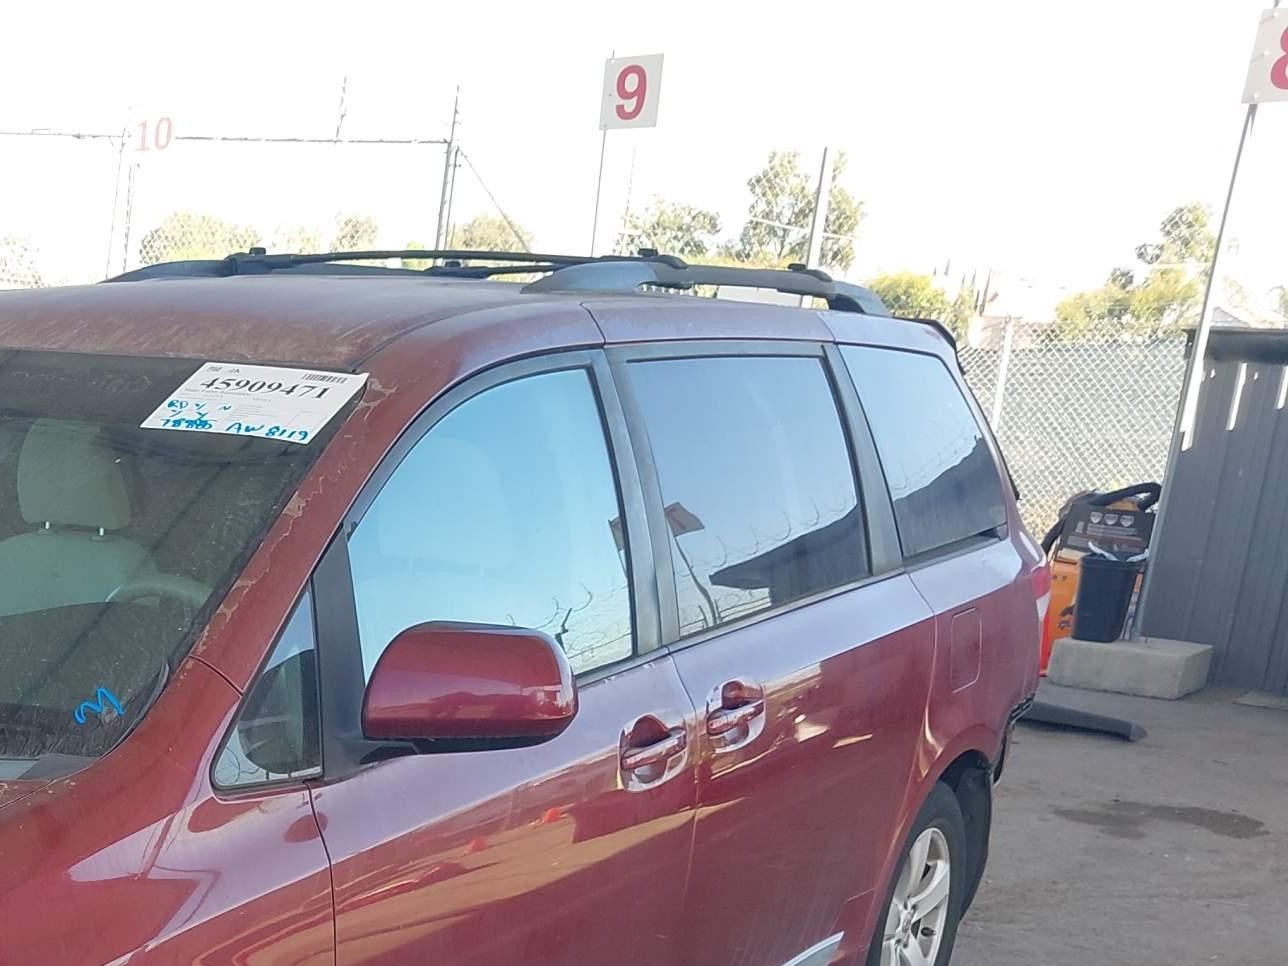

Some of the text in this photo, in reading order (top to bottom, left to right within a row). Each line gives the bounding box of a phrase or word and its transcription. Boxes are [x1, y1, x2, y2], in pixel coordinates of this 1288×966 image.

[616, 64, 646, 120] 9
[135, 116, 172, 151] 10
[200, 377, 330, 399] 45909471
[265, 425, 309, 440] 8119
